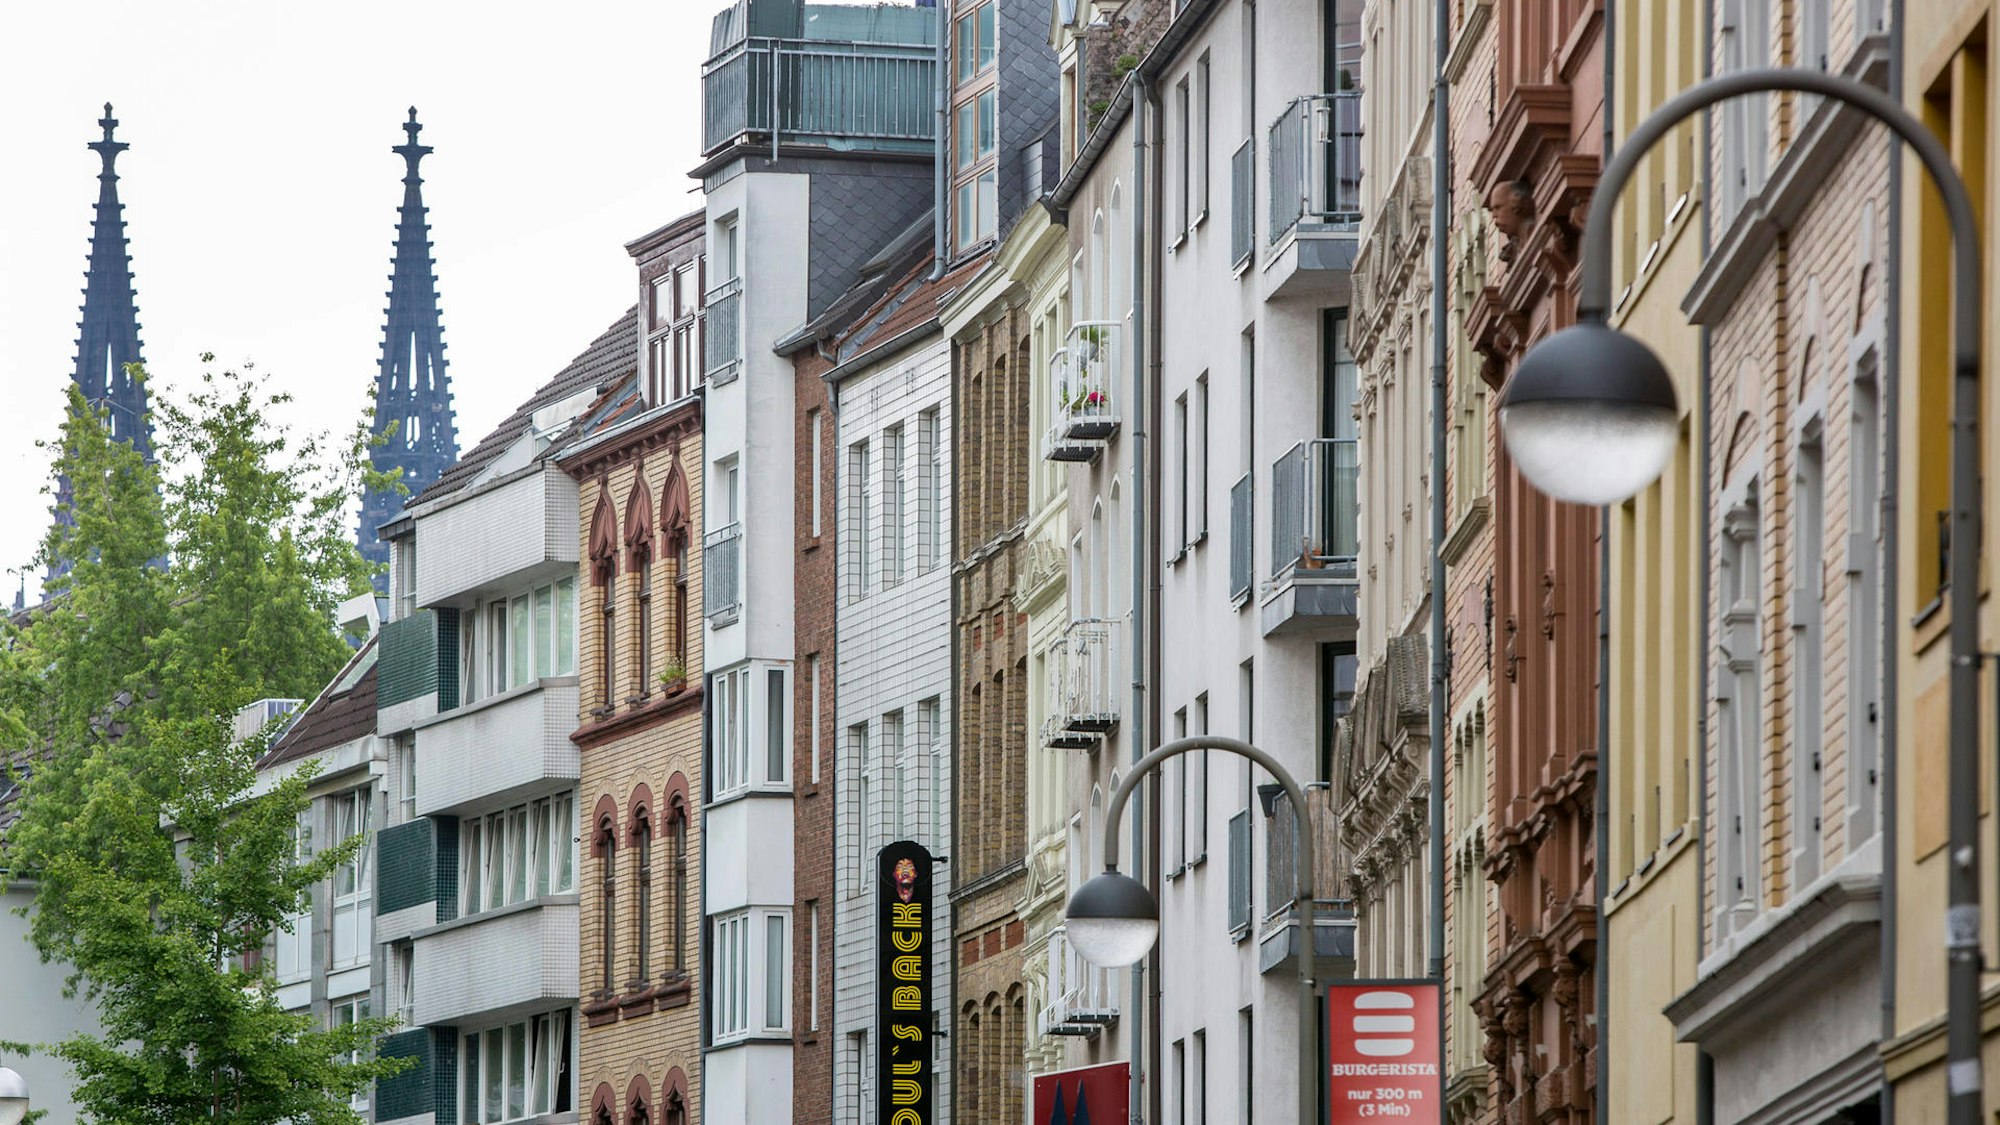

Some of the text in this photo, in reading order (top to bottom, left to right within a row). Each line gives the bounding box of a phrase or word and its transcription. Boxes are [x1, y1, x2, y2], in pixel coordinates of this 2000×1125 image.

[892, 902, 922, 1010] BACK
[1332, 1063, 1437, 1076] BURGERISTA
[1347, 1088, 1423, 1099] nur 300 m
[1359, 1103, 1411, 1117] (3 Min)
